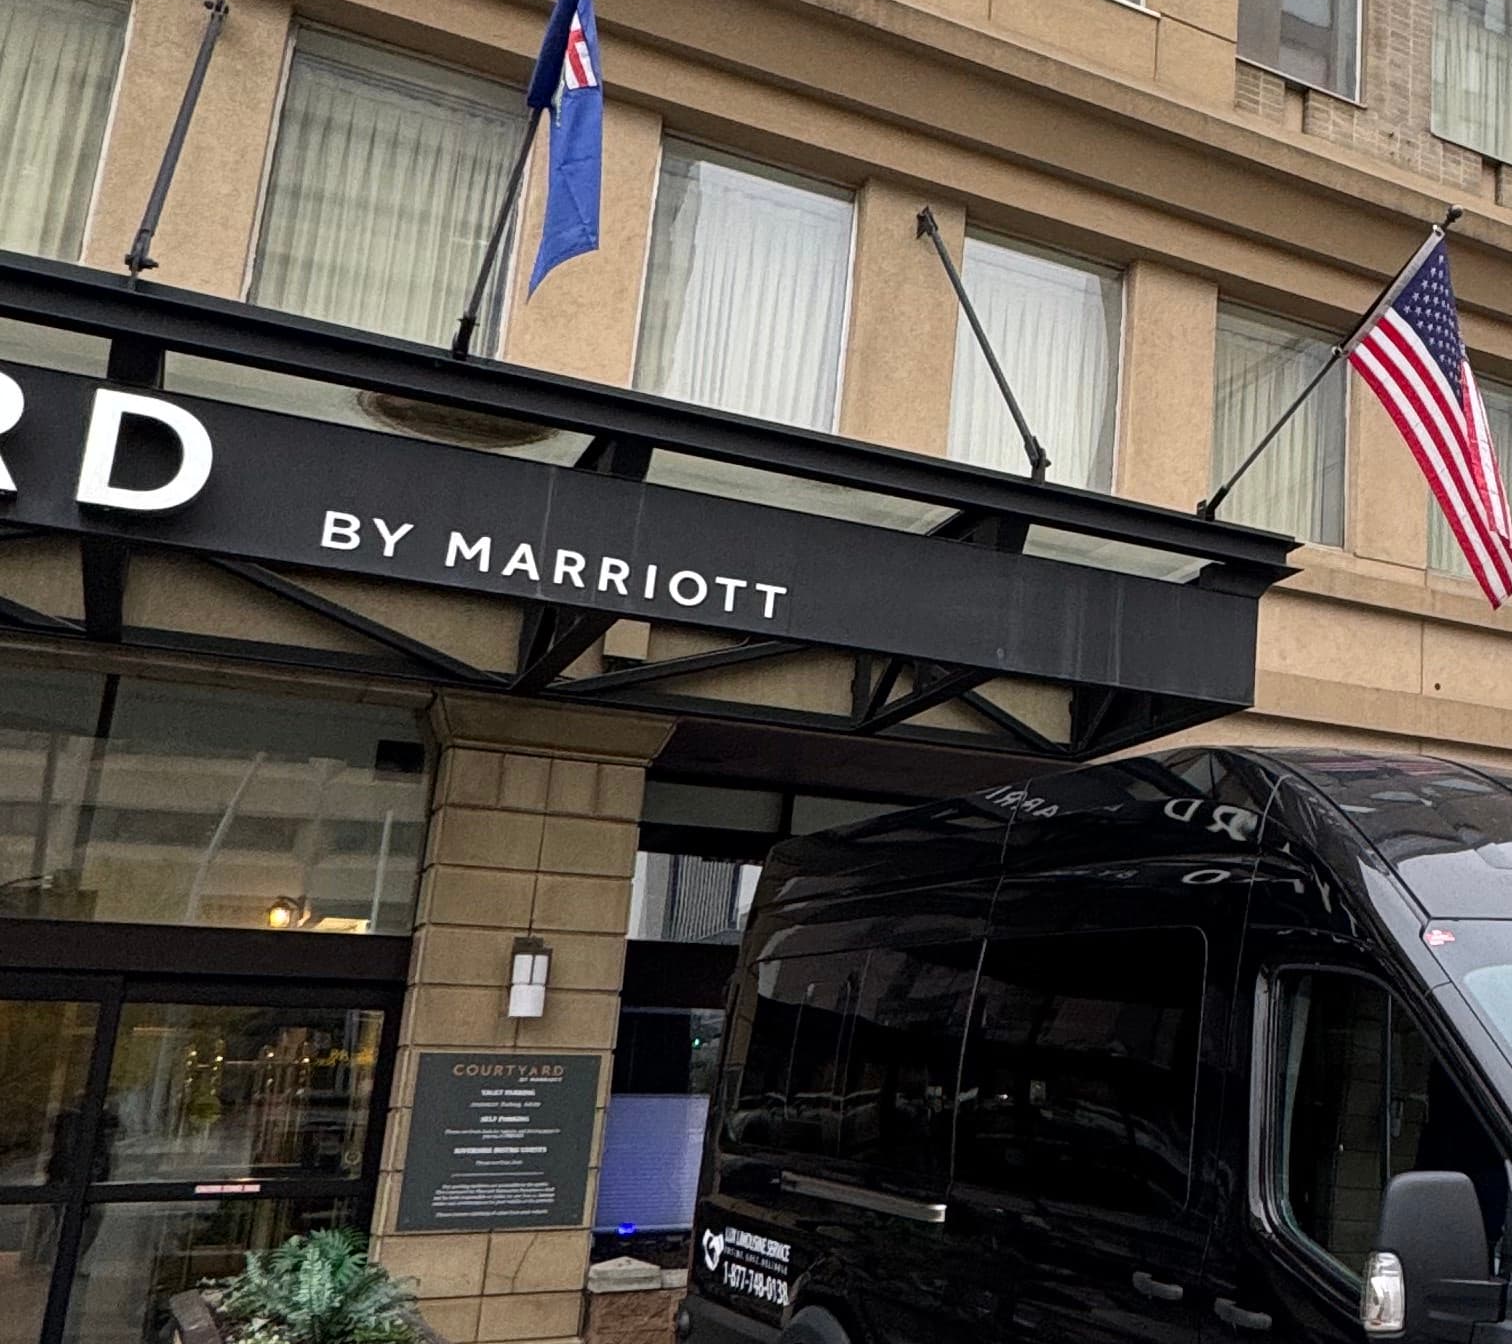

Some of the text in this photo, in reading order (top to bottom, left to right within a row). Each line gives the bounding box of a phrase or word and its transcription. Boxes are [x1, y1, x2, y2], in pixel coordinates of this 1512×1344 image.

[0, 372, 787, 619] D BY MARRIOTT
[453, 1064, 565, 1077] COURTYARD
